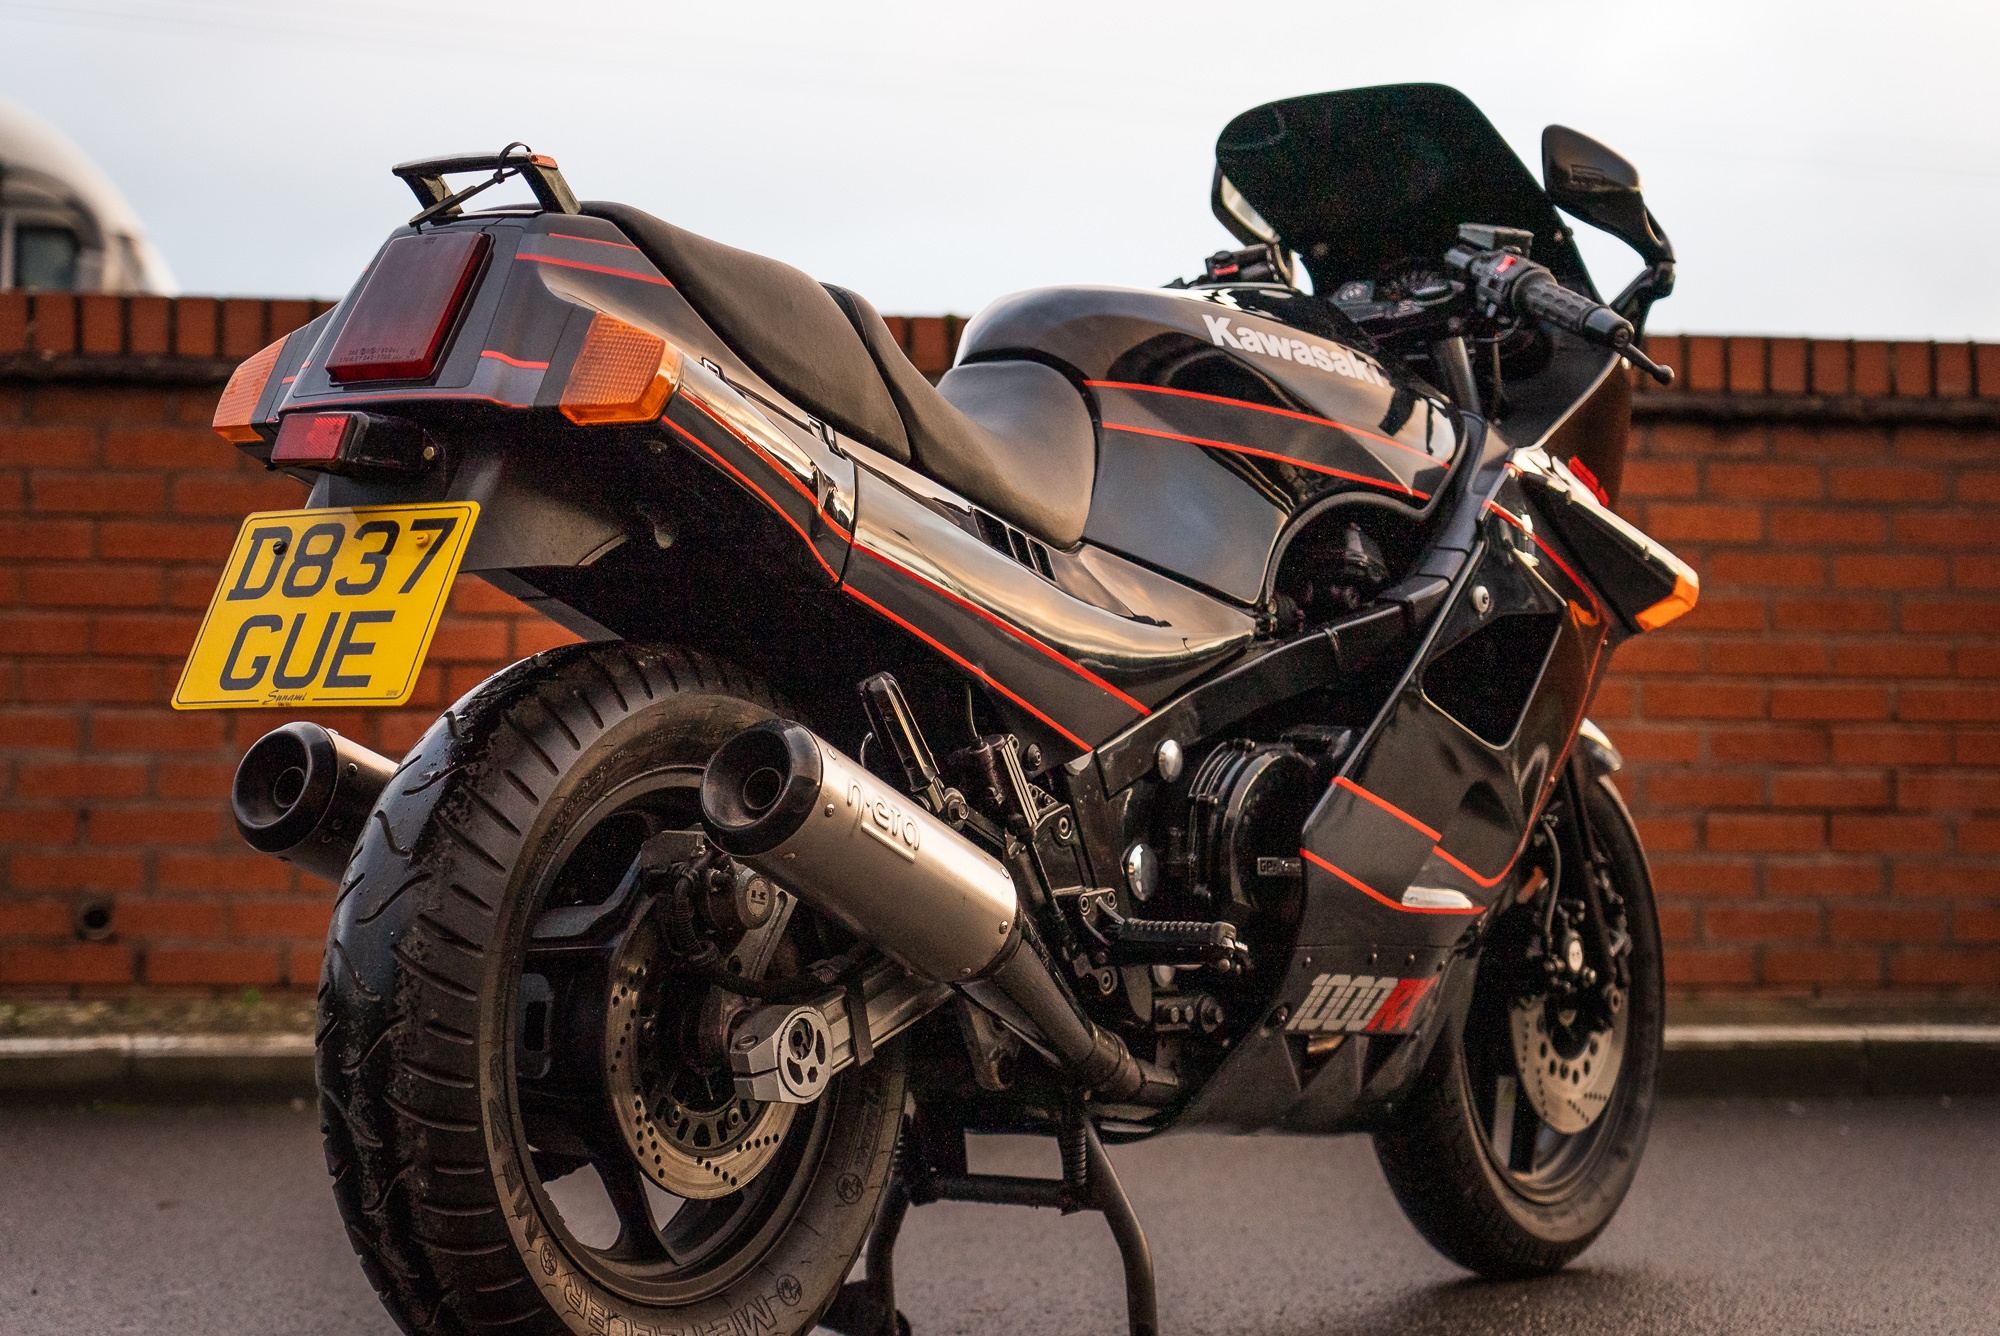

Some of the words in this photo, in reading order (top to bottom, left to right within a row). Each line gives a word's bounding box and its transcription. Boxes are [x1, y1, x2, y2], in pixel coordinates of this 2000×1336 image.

[1201, 314, 1385, 388] Kawasaki
[226, 517, 459, 601] D837
[219, 610, 396, 691] GUE
